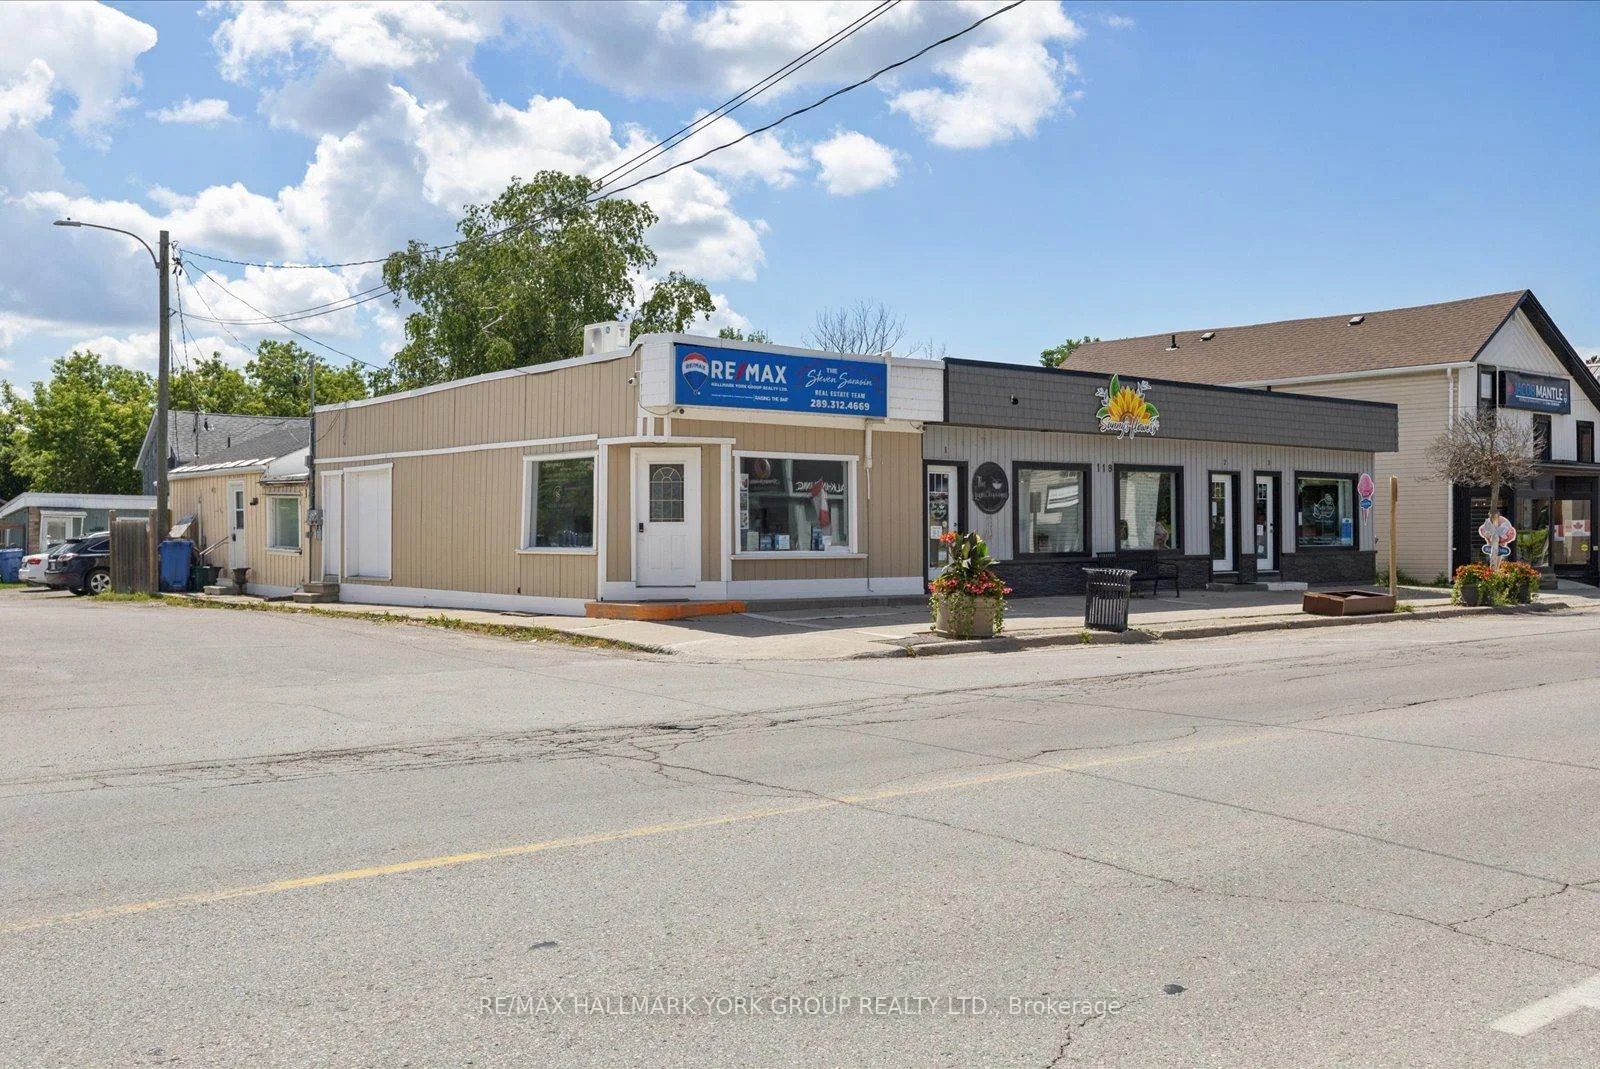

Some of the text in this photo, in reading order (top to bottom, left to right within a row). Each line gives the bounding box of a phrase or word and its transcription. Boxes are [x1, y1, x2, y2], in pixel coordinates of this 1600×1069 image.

[711, 360, 787, 384] RE/MAX
[805, 369, 837, 388] Steven
[815, 389, 829, 397] REAL
[830, 390, 850, 398] ESTATE
[1536, 385, 1563, 400] MANTLE
[810, 399, 870, 411] 289.312.4669
